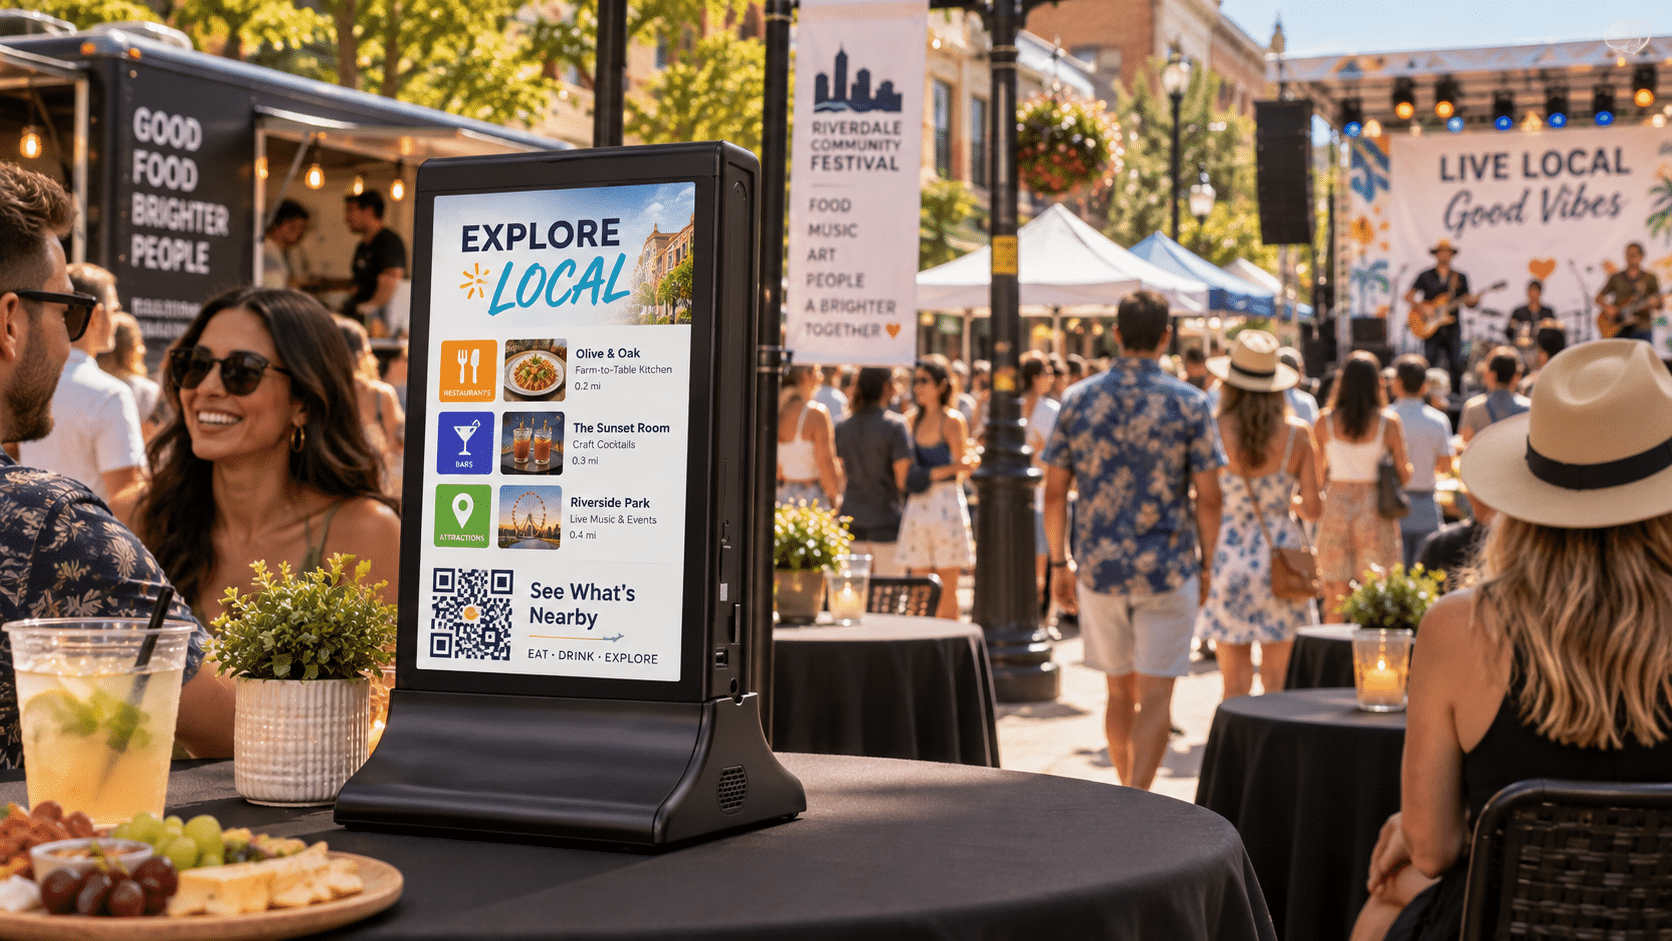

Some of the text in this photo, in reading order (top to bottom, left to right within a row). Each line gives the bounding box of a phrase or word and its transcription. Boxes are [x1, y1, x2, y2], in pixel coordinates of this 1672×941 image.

[133, 106, 203, 151] GOOD
[812, 121, 902, 136] RIVERDALE
[810, 138, 902, 152] COMMUNITY
[132, 149, 199, 192] FOOD
[810, 155, 900, 171] FESTIVAL
[1439, 147, 1632, 182] LIVE LOCAL
[809, 198, 852, 213] FOOD
[1443, 182, 1626, 239] Good Vibes
[131, 192, 230, 236] BRIGHTER
[461, 217, 621, 253] EXPLORE
[808, 223, 858, 238] MUSIC
[131, 234, 211, 275] PEOPLE
[807, 248, 836, 262] ART
[487, 252, 631, 316] LOCAL
[806, 273, 865, 289] PEOPLE
[804, 299, 896, 315] A BRIGHTER
[804, 322, 882, 340] TOGETHER
[575, 347, 641, 359] Olive & Oak
[575, 364, 673, 375] Farm-to-Table Kitchen
[443, 389, 491, 397] RESTAURANTS
[574, 381, 601, 391] 0.2 mi
[573, 422, 670, 434] The Sunset Room
[572, 439, 636, 450] Craft Cocktails
[455, 461, 474, 469] BARS
[572, 456, 599, 466] 0.3 mi
[570, 496, 650, 509] Riverside Park
[569, 514, 657, 526] Live Music & Events
[439, 533, 485, 542] ATTRACTIONS
[569, 530, 597, 540] 0.4 mi
[530, 582, 636, 602] See What's
[529, 606, 598, 630] Nearby
[528, 649, 548, 660] EAT
[558, 650, 594, 662] DRINK
[605, 653, 659, 666] EXPLORE
